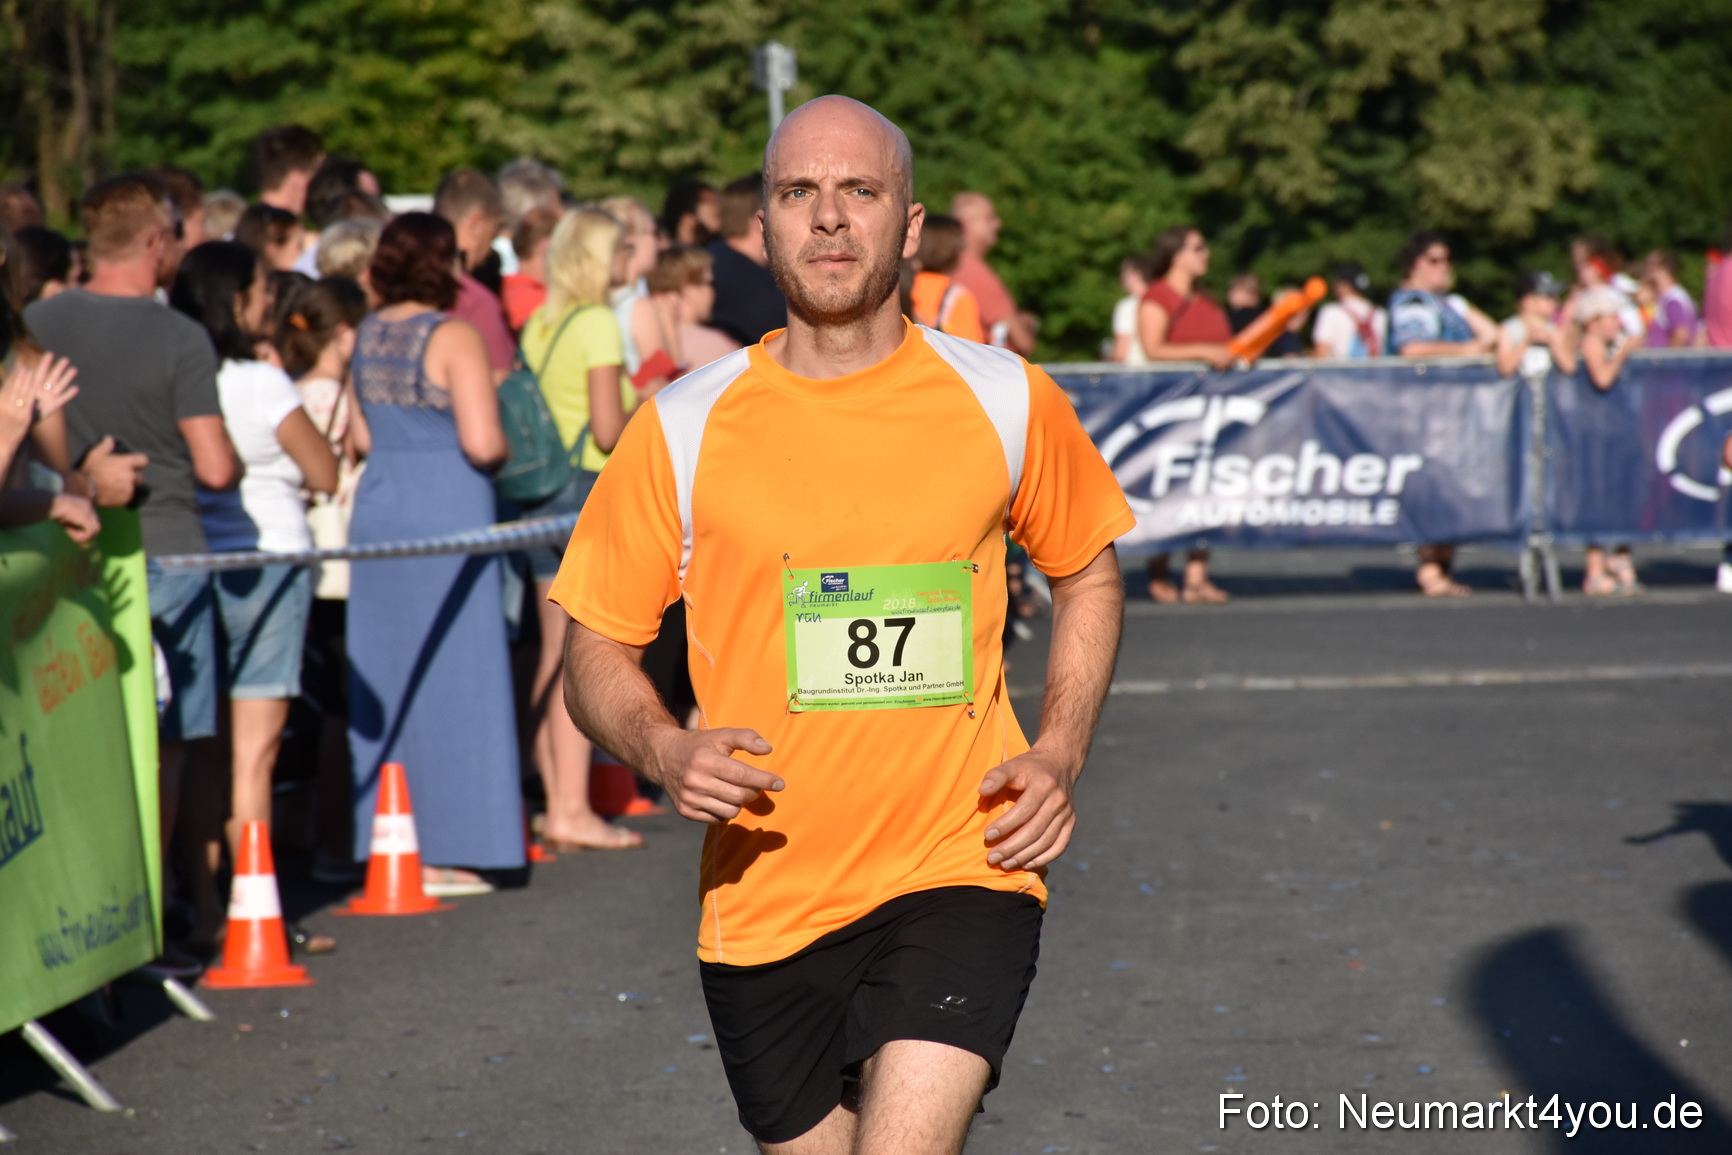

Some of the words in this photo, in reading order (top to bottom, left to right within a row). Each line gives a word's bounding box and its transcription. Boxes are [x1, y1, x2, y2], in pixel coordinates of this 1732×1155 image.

[1151, 439, 1424, 498] Fischer
[1179, 499, 1400, 526] AUTOMOBILE
[809, 588, 875, 602] firmenlauf
[882, 597, 916, 610] 2018
[847, 617, 916, 670] 87
[844, 671, 895, 687] Spotka
[899, 670, 924, 683] Jan
[797, 687, 855, 696] Baugrundinstitut
[856, 686, 882, 694] Dr.-Ing.
[883, 684, 907, 693] Spotka
[908, 683, 921, 691] und
[922, 682, 945, 690] Partner
[945, 680, 965, 688] GmbH
